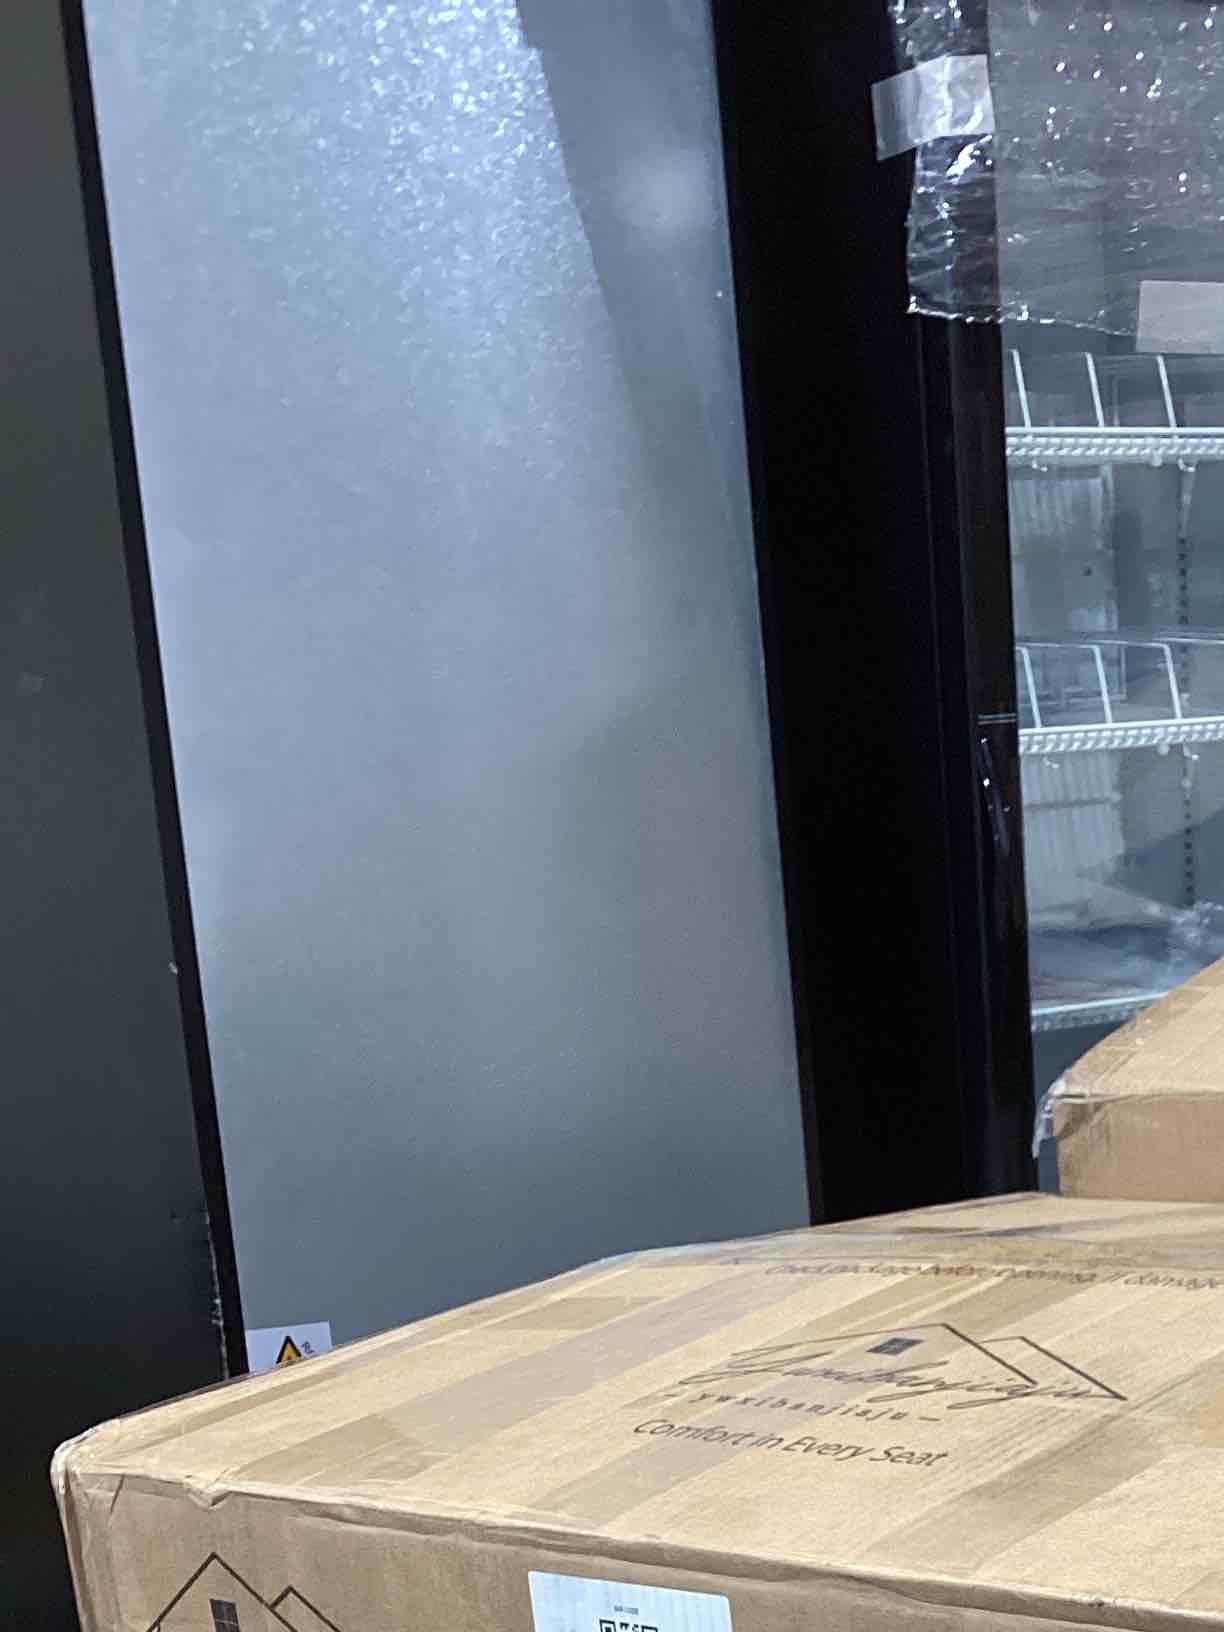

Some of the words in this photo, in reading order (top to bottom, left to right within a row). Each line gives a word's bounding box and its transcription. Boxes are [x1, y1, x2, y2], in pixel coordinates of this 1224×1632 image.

[634, 1418, 755, 1446] Comfort
[749, 1432, 784, 1450] in
[782, 1435, 876, 1462] Every
[868, 1445, 949, 1467] Seat
